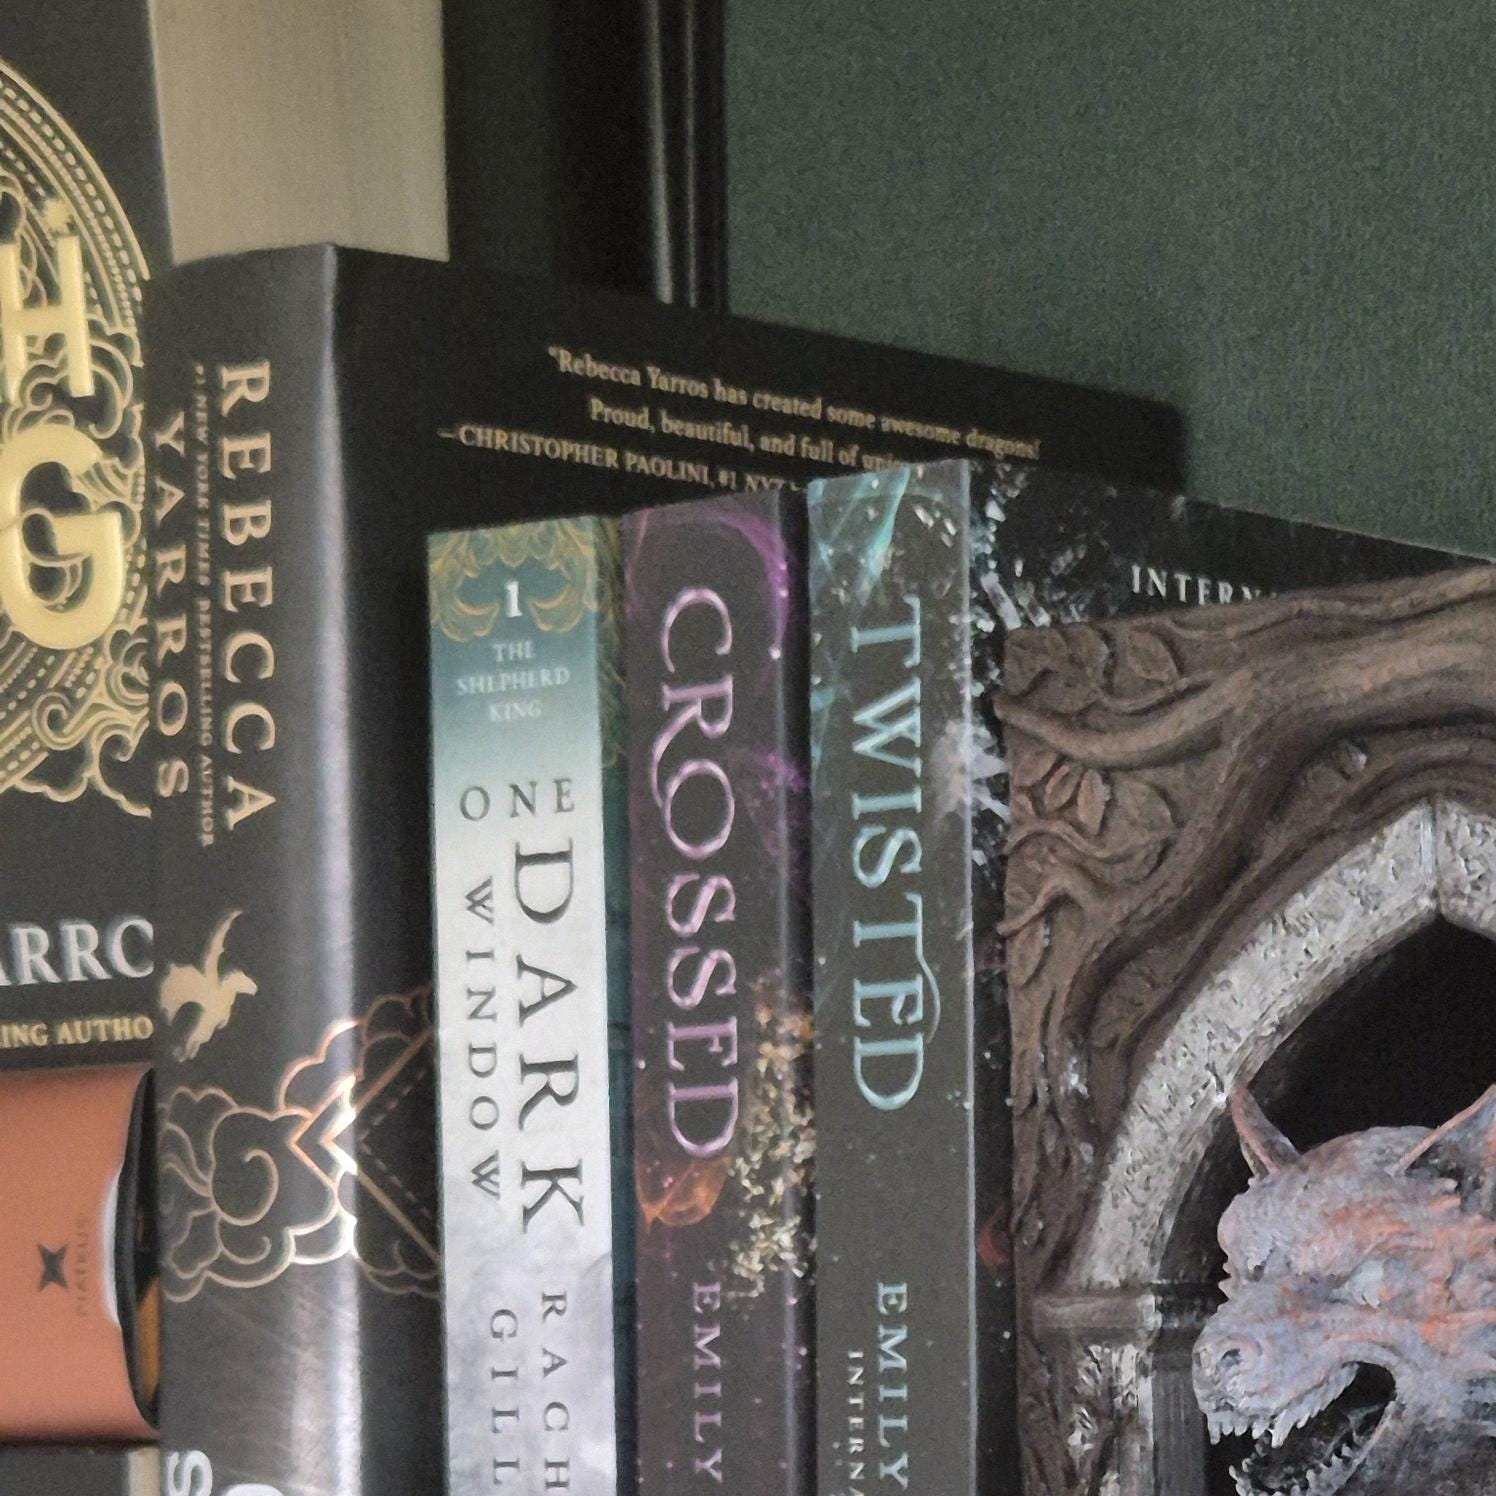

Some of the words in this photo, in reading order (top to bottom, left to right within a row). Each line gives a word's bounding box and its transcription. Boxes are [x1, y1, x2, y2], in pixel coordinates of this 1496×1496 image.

[589, 396, 655, 434] Proud,
[660, 408, 755, 453] beautiful,
[760, 432, 797, 457] and
[800, 436, 835, 464] full
[838, 444, 860, 467] of
[646, 365, 709, 399] Yarros
[713, 376, 748, 406] has
[753, 391, 822, 421] created
[826, 405, 876, 430] some
[880, 416, 961, 446] awesome
[196, 450, 209, 510] YORK
[624, 452, 715, 490] PAOLINI,
[197, 516, 211, 587] TIMES
[154, 408, 190, 798] YARROS
[219, 358, 277, 831] REBECCA
[504, 580, 522, 618] 1
[455, 665, 571, 696] SHEPHERD
[492, 639, 536, 662] THE
[488, 699, 541, 722] KING
[200, 754, 214, 847] AUTHOR
[458, 777, 575, 823] ONE
[649, 585, 740, 1157] CROSSED
[849, 594, 941, 1111] TWISTED
[55, 1015, 154, 1044] AUTHO
[463, 876, 503, 1199] WINDOW
[511, 838, 586, 1234] DARK
[690, 1281, 722, 1483] EMILY
[876, 1280, 910, 1492] EMILY
